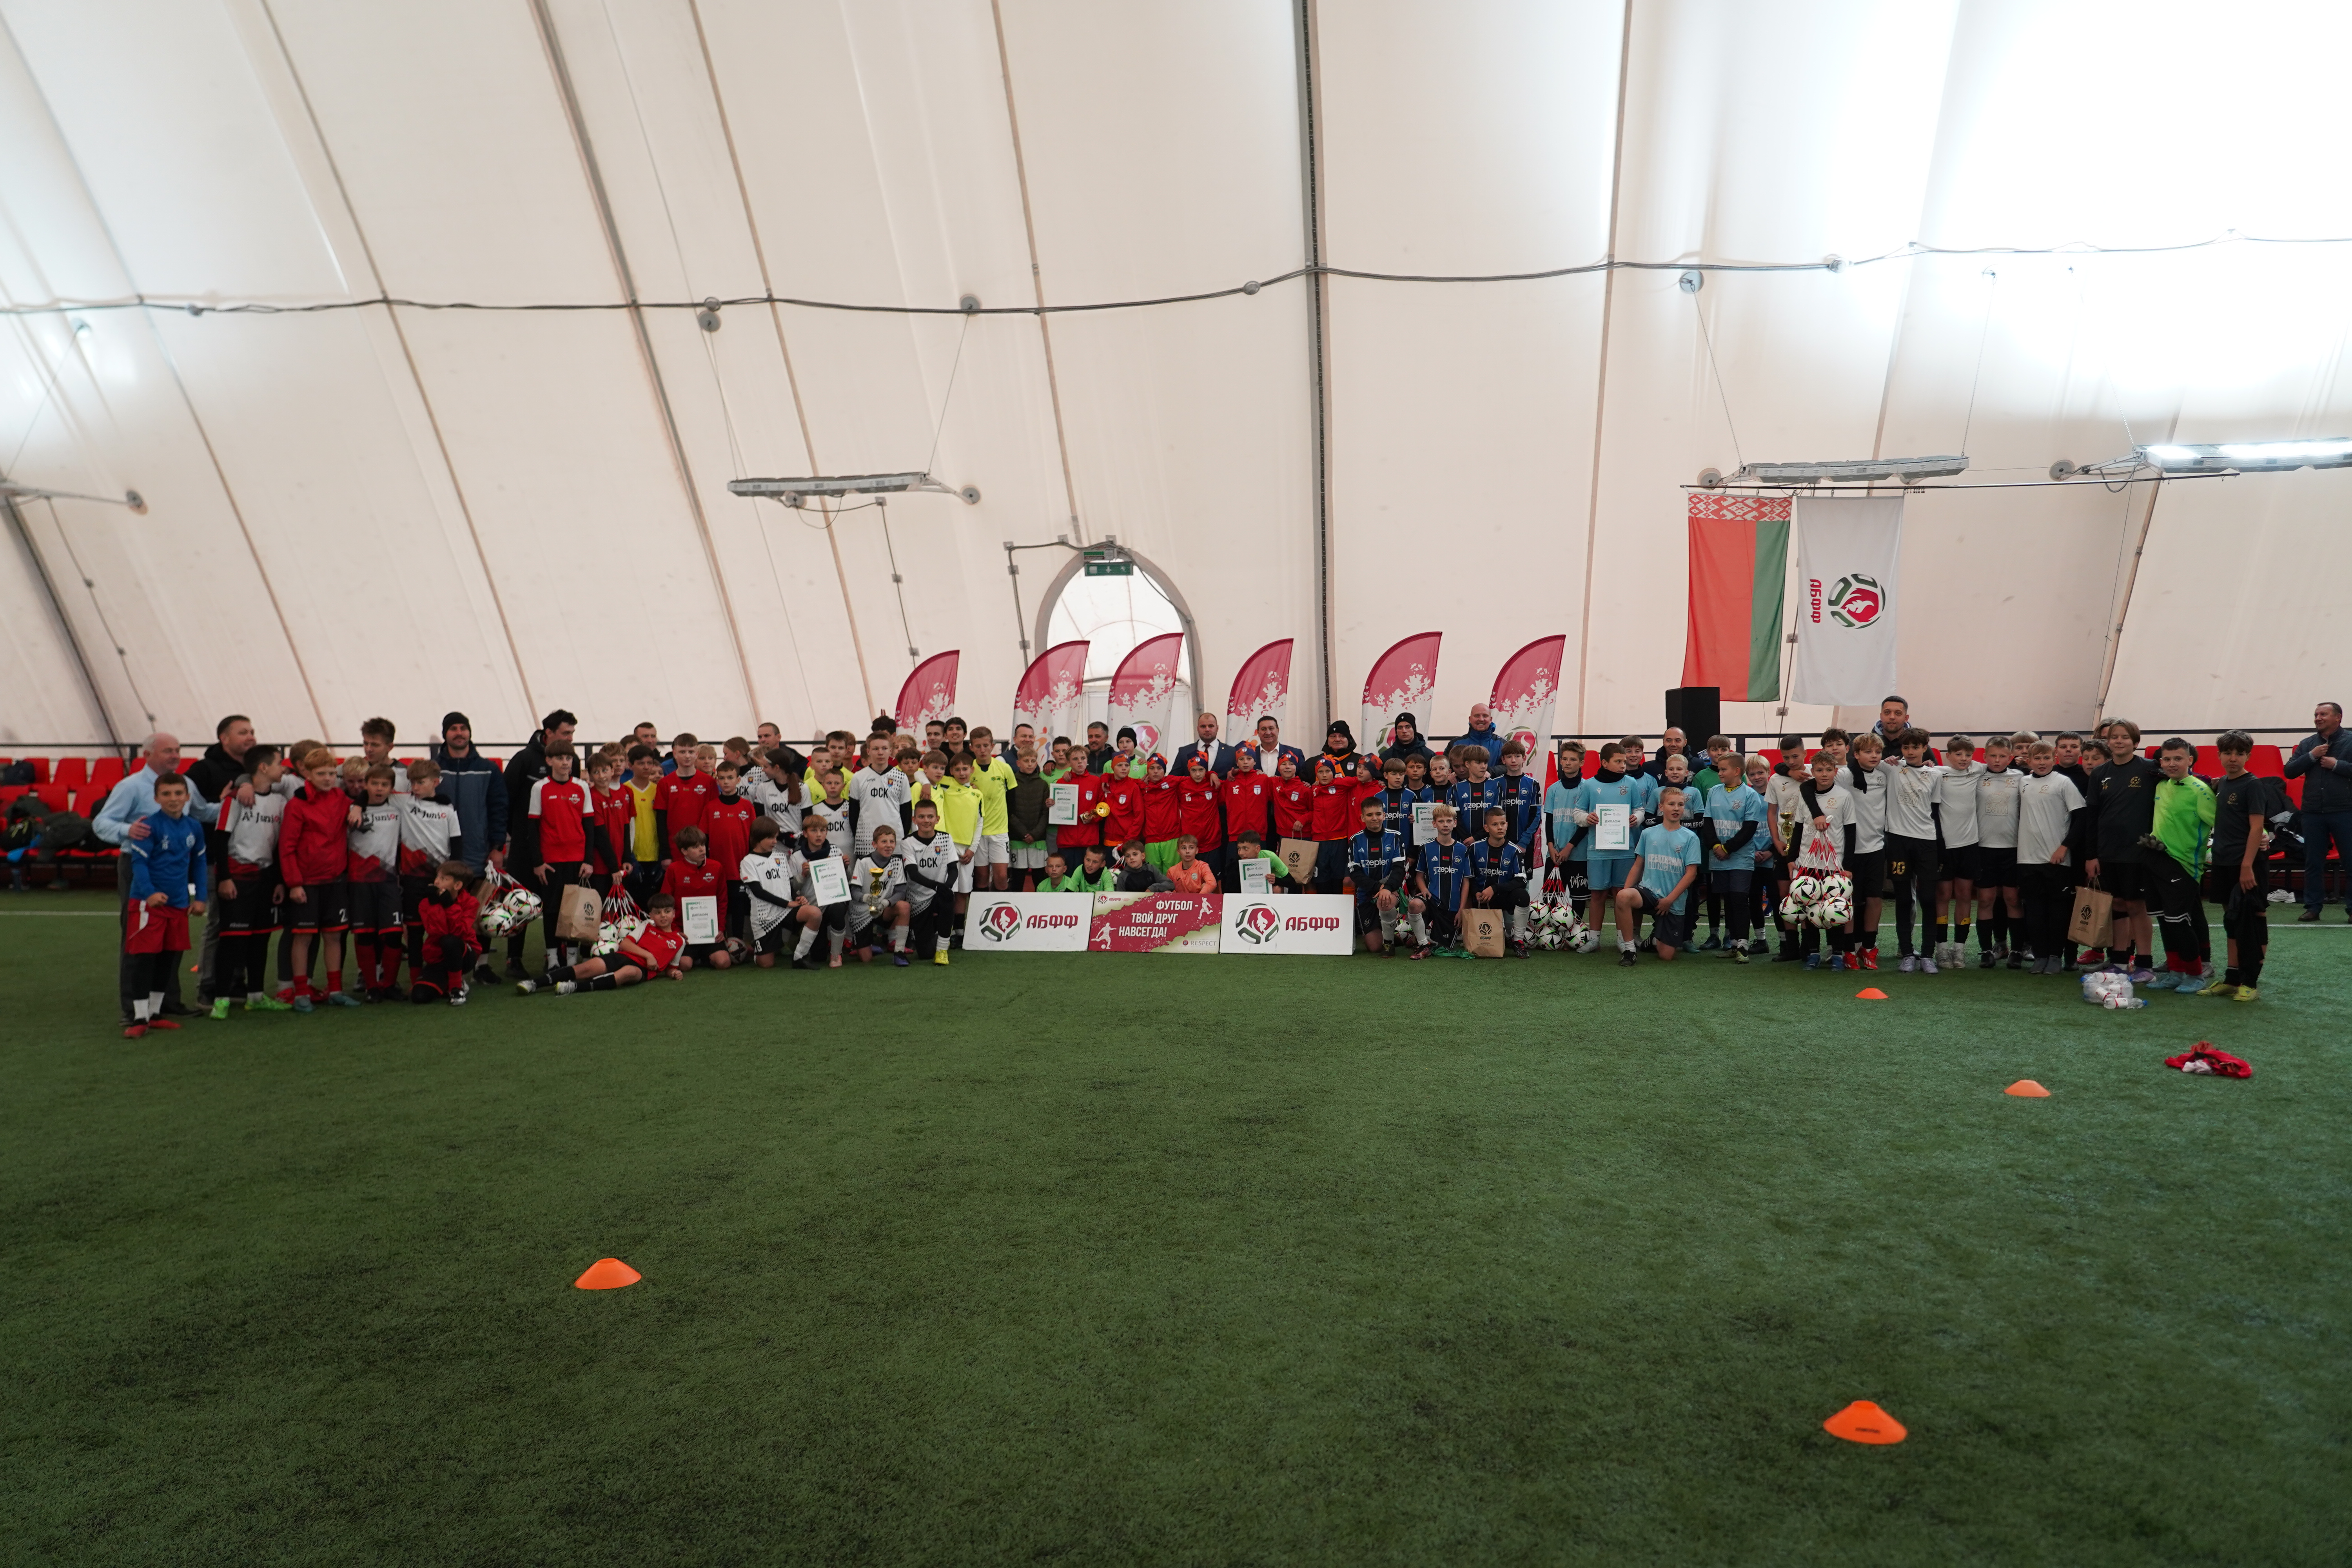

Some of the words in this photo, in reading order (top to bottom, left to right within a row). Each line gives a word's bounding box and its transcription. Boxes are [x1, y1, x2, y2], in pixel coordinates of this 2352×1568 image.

[1809, 579, 1822, 624] АБФФ
[871, 787, 889, 798] ФСК
[1468, 801, 1492, 810] zepter
[1503, 797, 1526, 806] zepter
[772, 802, 789, 813] ФСК
[371, 813, 399, 822] Junior
[422, 811, 446, 819] Junio
[1385, 811, 1408, 821] zepter
[827, 821, 845, 831] ФСК
[919, 857, 938, 868] ФСК
[1365, 858, 1390, 867] zepter
[1891, 861, 1905, 875] 20
[766, 868, 781, 880] ФСК
[1437, 865, 1458, 874] zepter
[1483, 867, 1508, 876] zepter
[1156, 900, 1193, 911] ФУТБОЛ
[393, 911, 403, 925] 1
[1026, 915, 1078, 929] АБФФ
[1131, 911, 1154, 923] ТВОЙ
[1154, 913, 1179, 924] ДРУГ
[1285, 917, 1339, 931] АБФФ
[1118, 926, 1167, 938] НАВСЕГДА!
